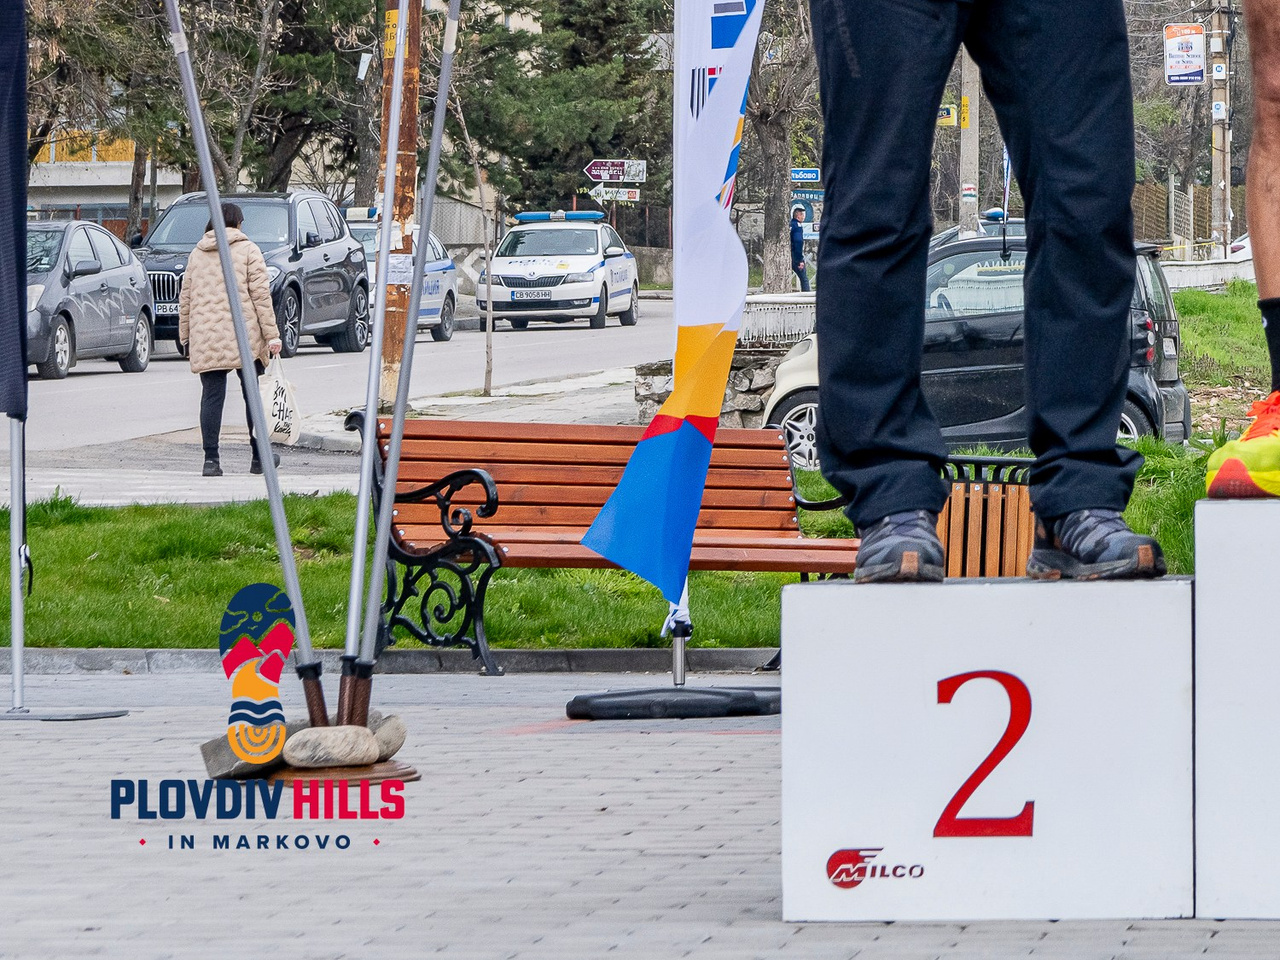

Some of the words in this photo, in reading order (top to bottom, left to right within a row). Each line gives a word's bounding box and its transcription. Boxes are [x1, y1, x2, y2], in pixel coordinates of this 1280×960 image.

[524, 291, 540, 299] 9058
[157, 304, 168, 313] PB
[933, 668, 1035, 838] 2
[829, 862, 925, 883] MILCO
